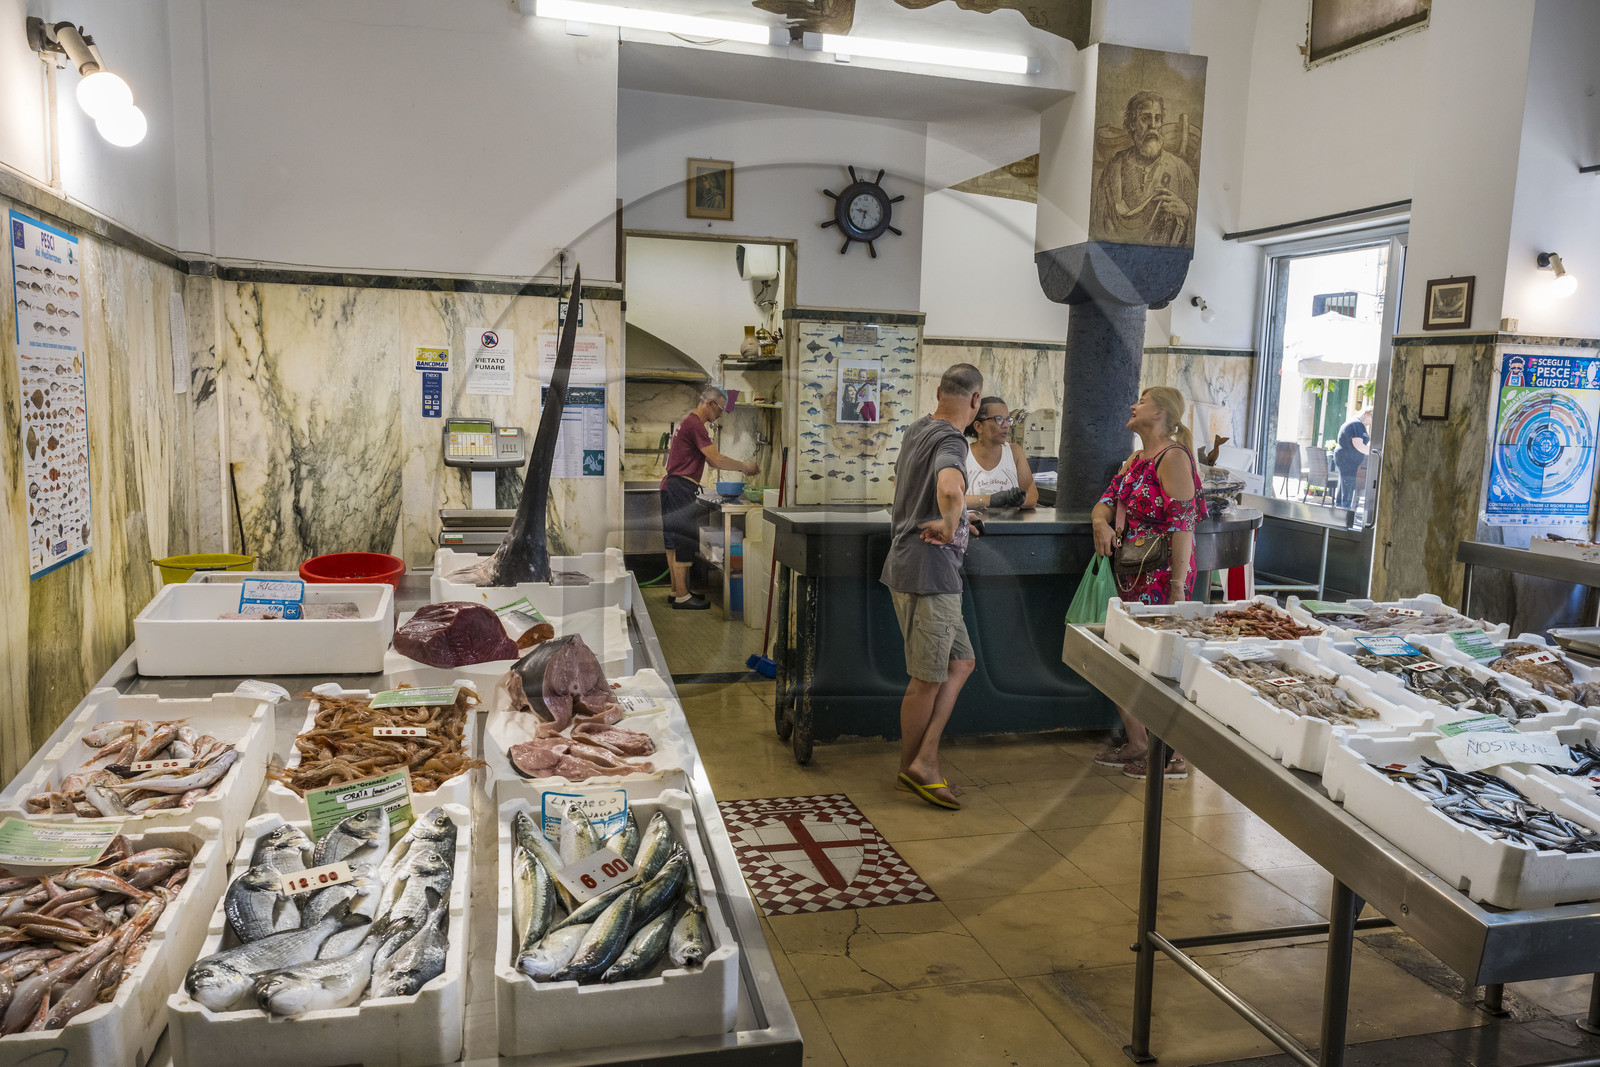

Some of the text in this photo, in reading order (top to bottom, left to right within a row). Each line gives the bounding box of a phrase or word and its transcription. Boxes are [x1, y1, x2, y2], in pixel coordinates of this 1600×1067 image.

[41, 232, 56, 250] PESCI
[416, 349, 438, 360] Pago
[1538, 358, 1563, 366] SCEGLI
[1537, 367, 1570, 378] PESCE
[1536, 378, 1569, 388] GIUSTO
[1501, 389, 1530, 418] PRIMAVERA
[1495, 474, 1515, 498] INVERNO
[1466, 739, 1555, 757] NOSTRANE
[324, 786, 356, 796] Pescheria
[343, 792, 368, 801] ORATA
